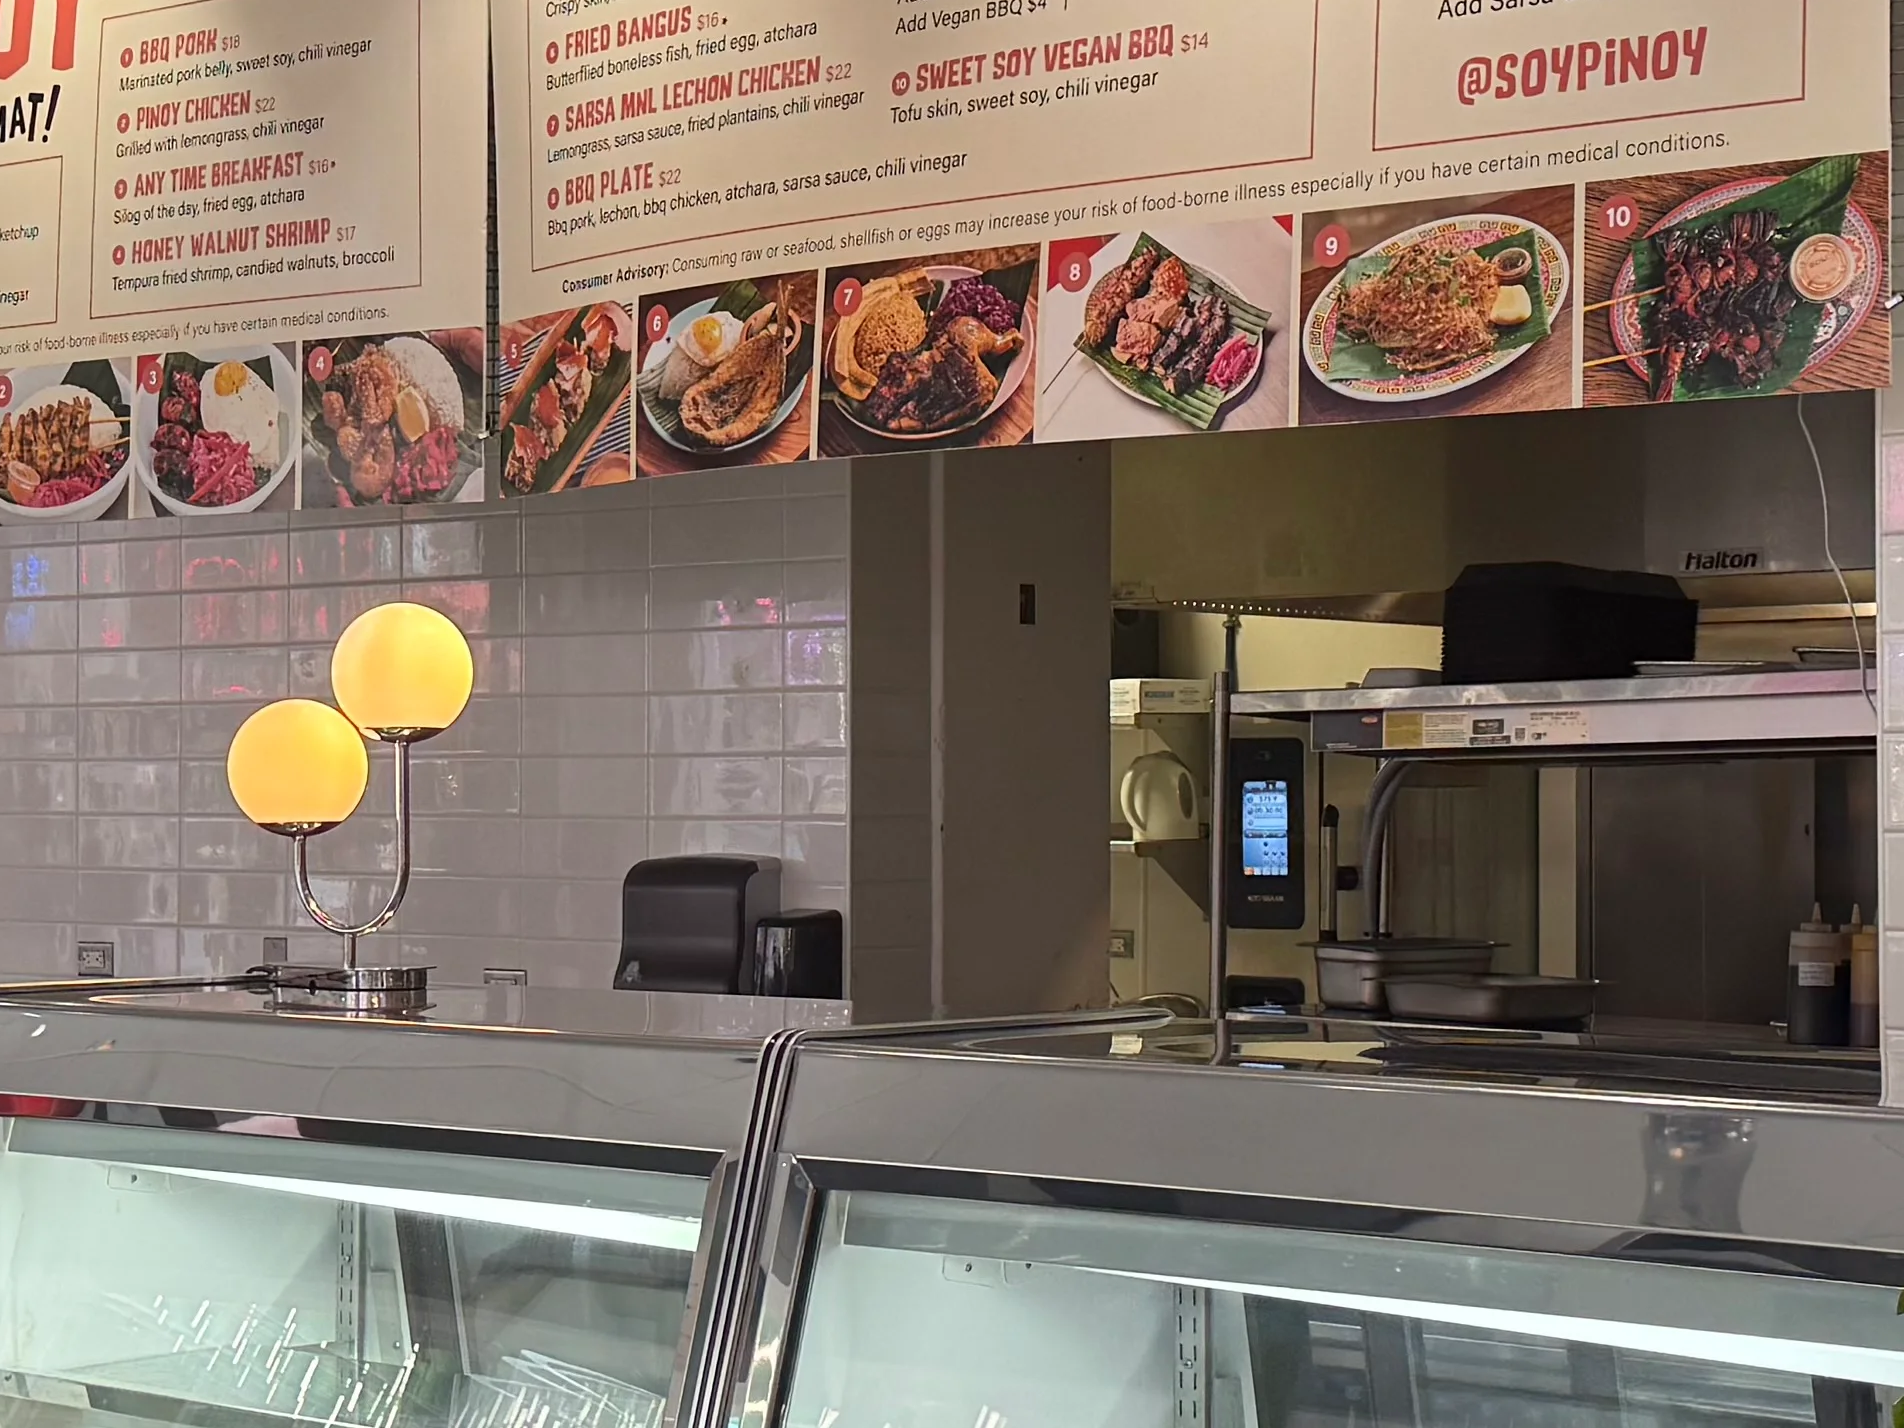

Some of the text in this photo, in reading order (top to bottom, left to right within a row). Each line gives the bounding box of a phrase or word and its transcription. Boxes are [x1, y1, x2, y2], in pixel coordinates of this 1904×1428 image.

[565, 23, 611, 60] FRIED
[616, 5, 692, 48] BANGUS
[139, 36, 170, 65] BBQ
[175, 27, 218, 59] PORK
[916, 23, 1209, 93] SWEET SOY VEGAN BBQ $14
[565, 55, 852, 133] SARSA MNL LECHON CHICKEN $22
[890, 71, 1159, 124] Tofu skin, sweet soy, chili vinegar
[136, 89, 276, 132] PINOY CHICKEN $22
[133, 171, 166, 198] ANY
[170, 165, 207, 193] TIME
[211, 150, 304, 188] BREAKFAST
[565, 161, 681, 206] BBQ PLATE $22
[1606, 206, 1631, 228] 10
[131, 217, 356, 264] HONEY WALNUT SHRIMP $17
[1325, 237, 1338, 256] 9
[1069, 263, 1081, 281] 8
[843, 288, 853, 306] 7
[653, 315, 662, 332] 6
[511, 343, 518, 359] 5
[315, 356, 325, 371] 4
[149, 370, 157, 385] 3
[0, 385, 6, 399] 2
[1684, 551, 1758, 571] Halton
